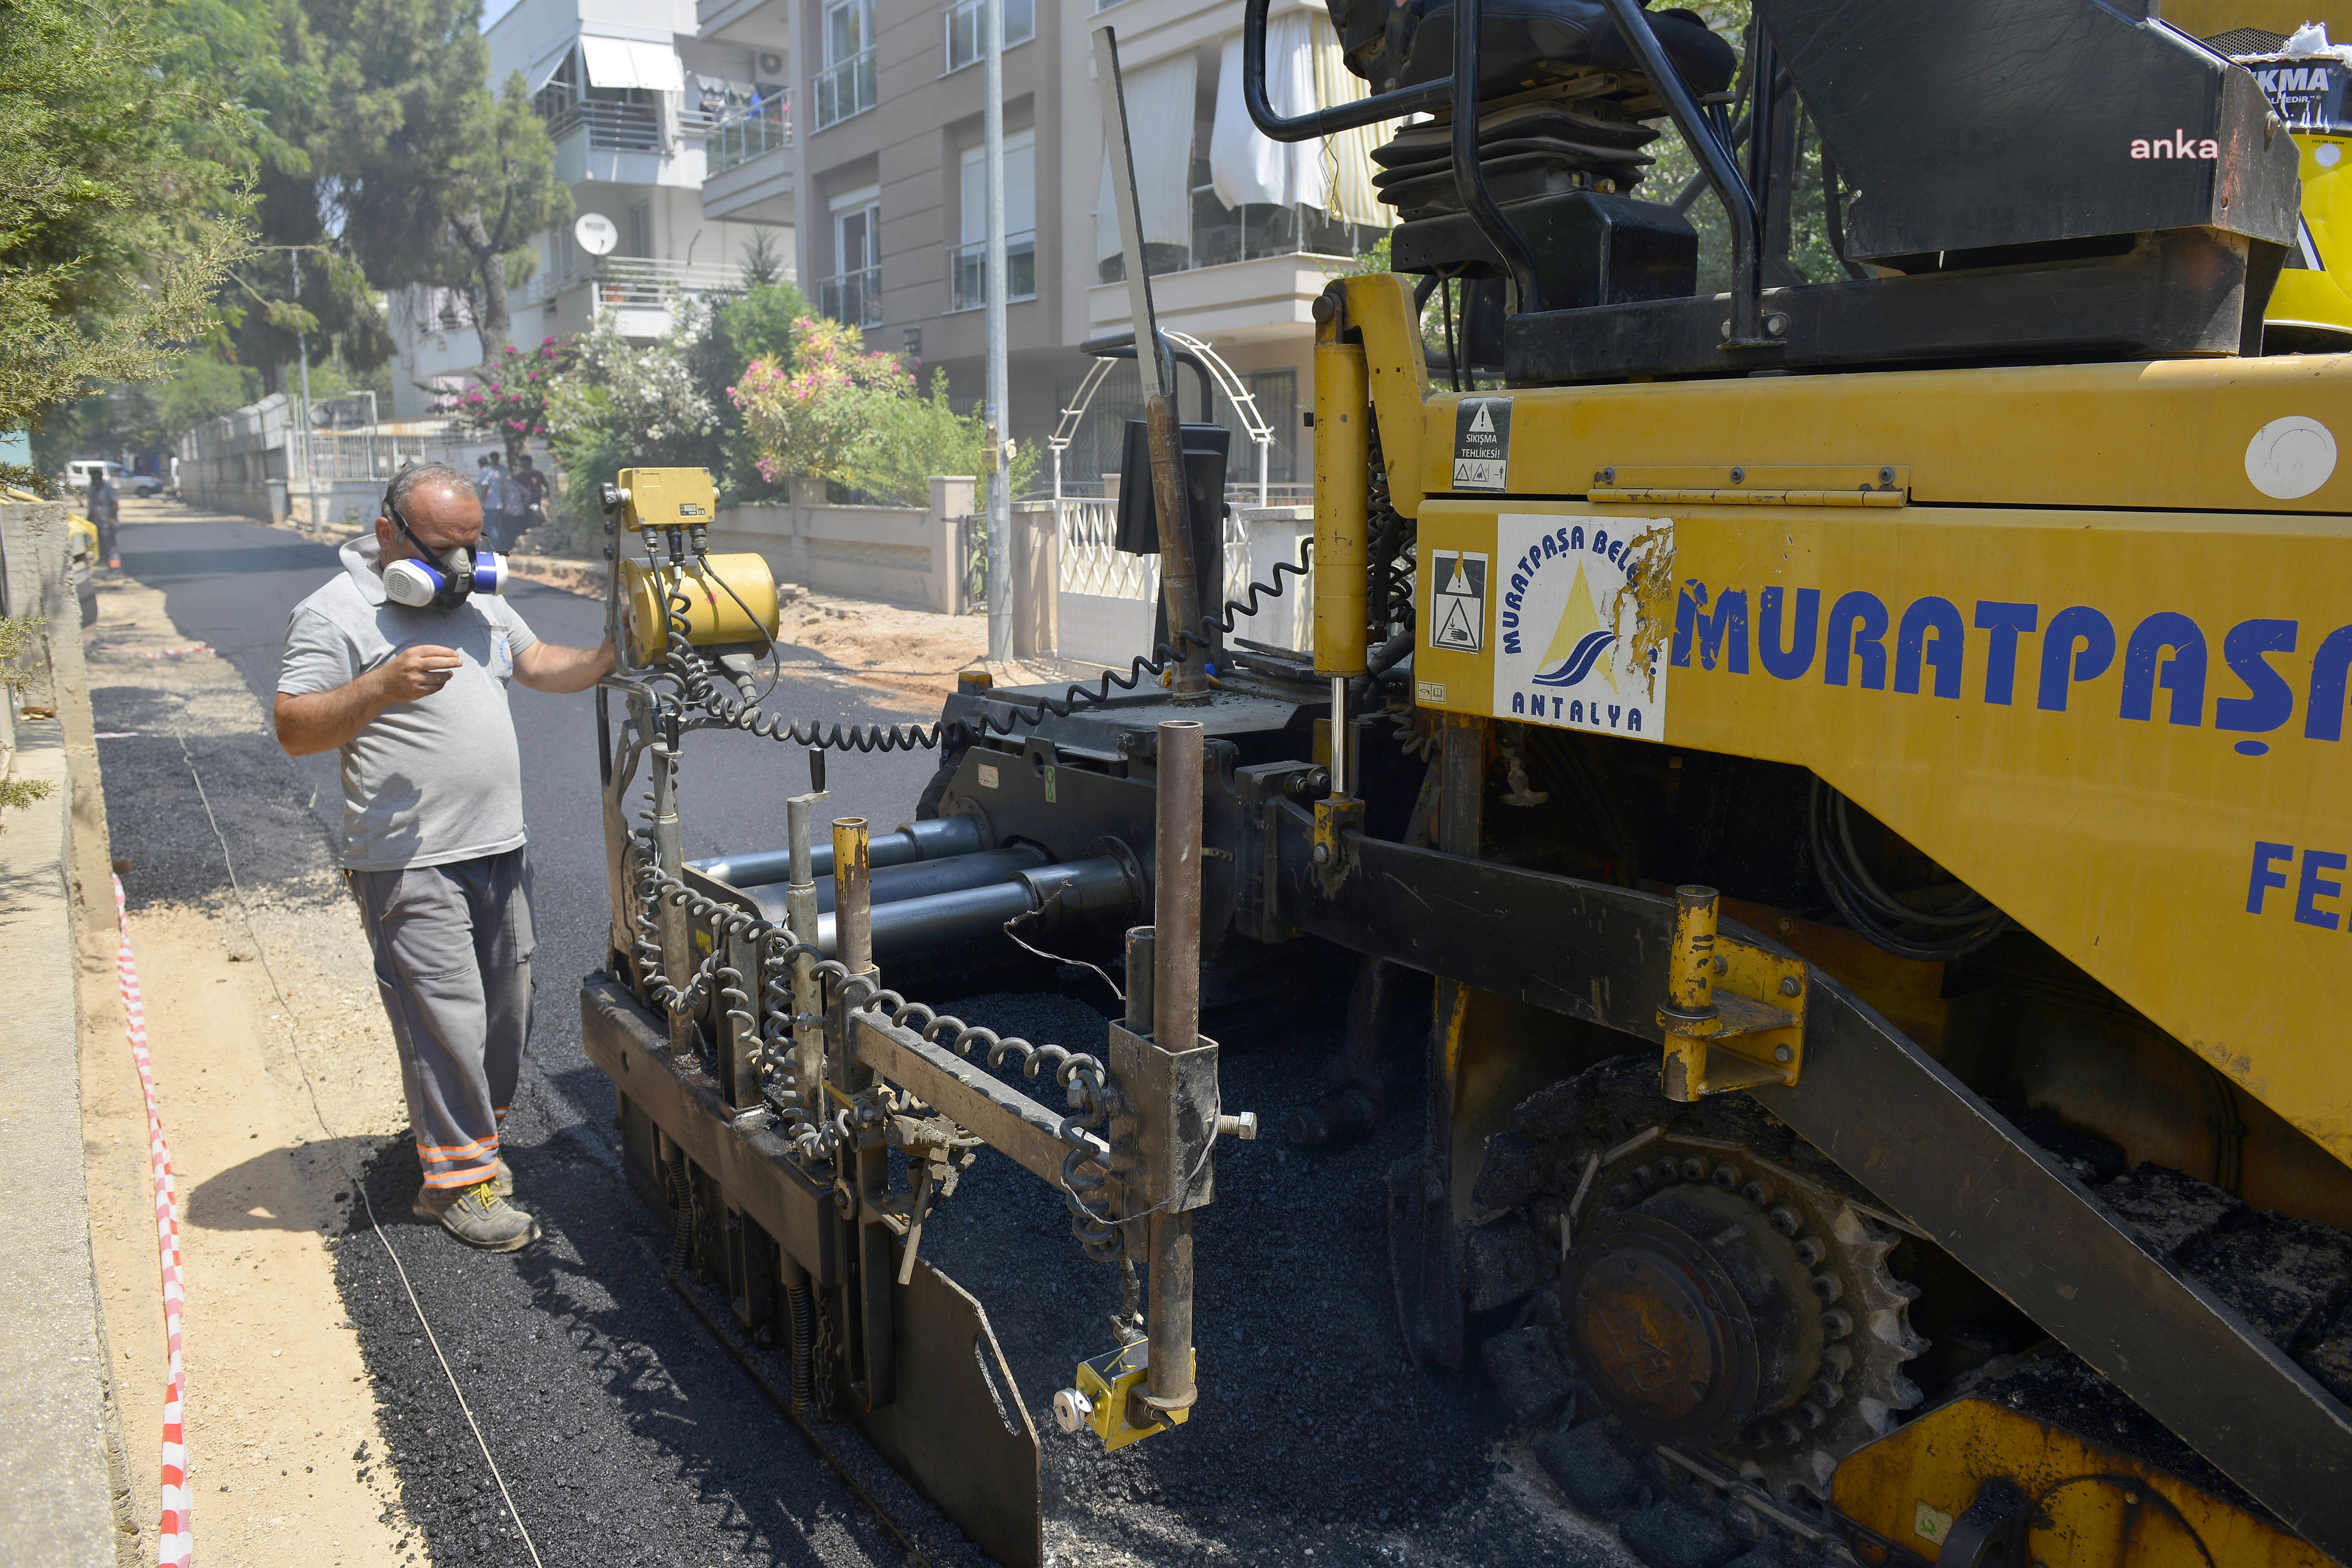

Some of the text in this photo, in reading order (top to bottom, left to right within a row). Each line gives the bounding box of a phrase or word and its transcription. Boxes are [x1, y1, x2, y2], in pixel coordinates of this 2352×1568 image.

[2252, 68, 2329, 92] KMA
[1461, 447, 1500, 458] TEHLİKESİ!
[1466, 434, 1497, 445] SIKIŞMA
[1503, 525, 1585, 654] MURATPAŞA
[1513, 692, 1642, 732] ANTALYA
[2245, 841, 2352, 933] FE
